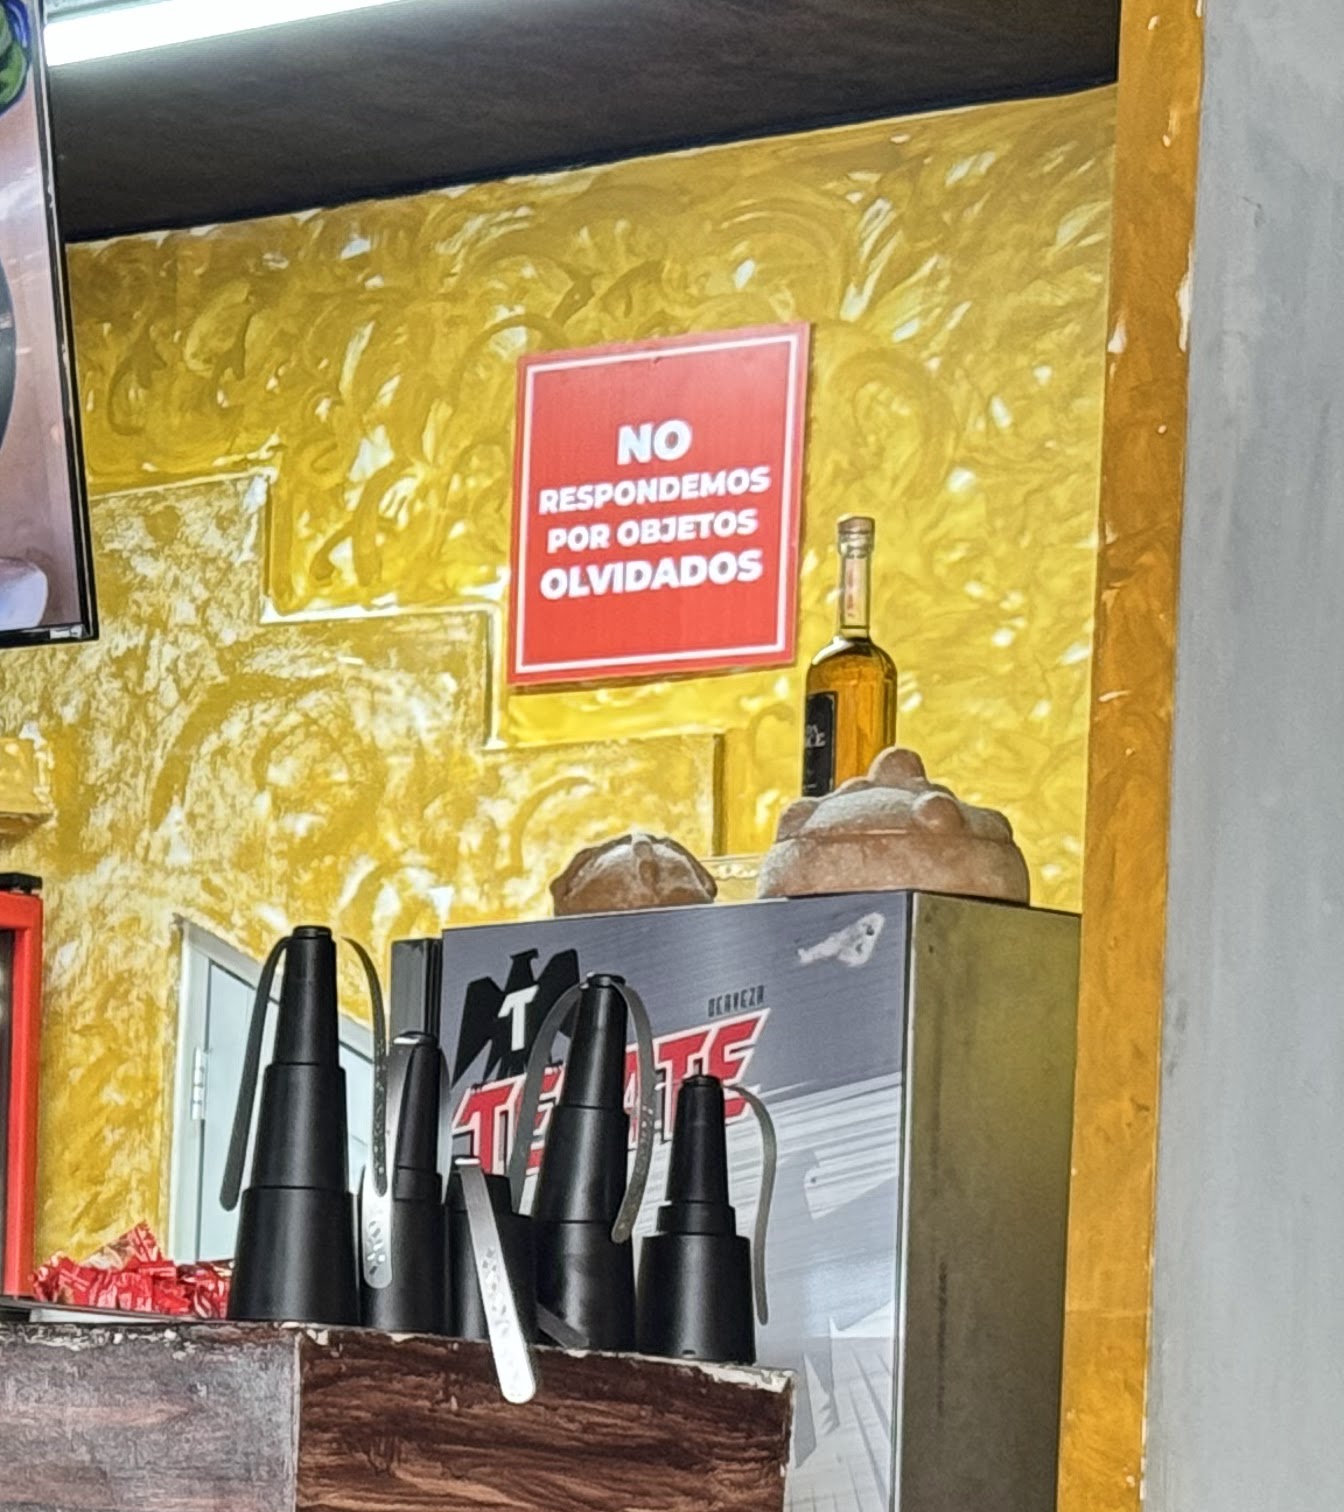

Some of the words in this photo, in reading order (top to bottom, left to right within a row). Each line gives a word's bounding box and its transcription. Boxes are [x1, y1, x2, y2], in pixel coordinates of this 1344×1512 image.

[617, 419, 693, 465] NO
[538, 466, 772, 515] RESPONDEMOS
[547, 523, 611, 553] POR
[617, 508, 759, 547] OBJETOS
[540, 550, 764, 600] OLVIDADOS
[451, 1007, 771, 1176] TETE
